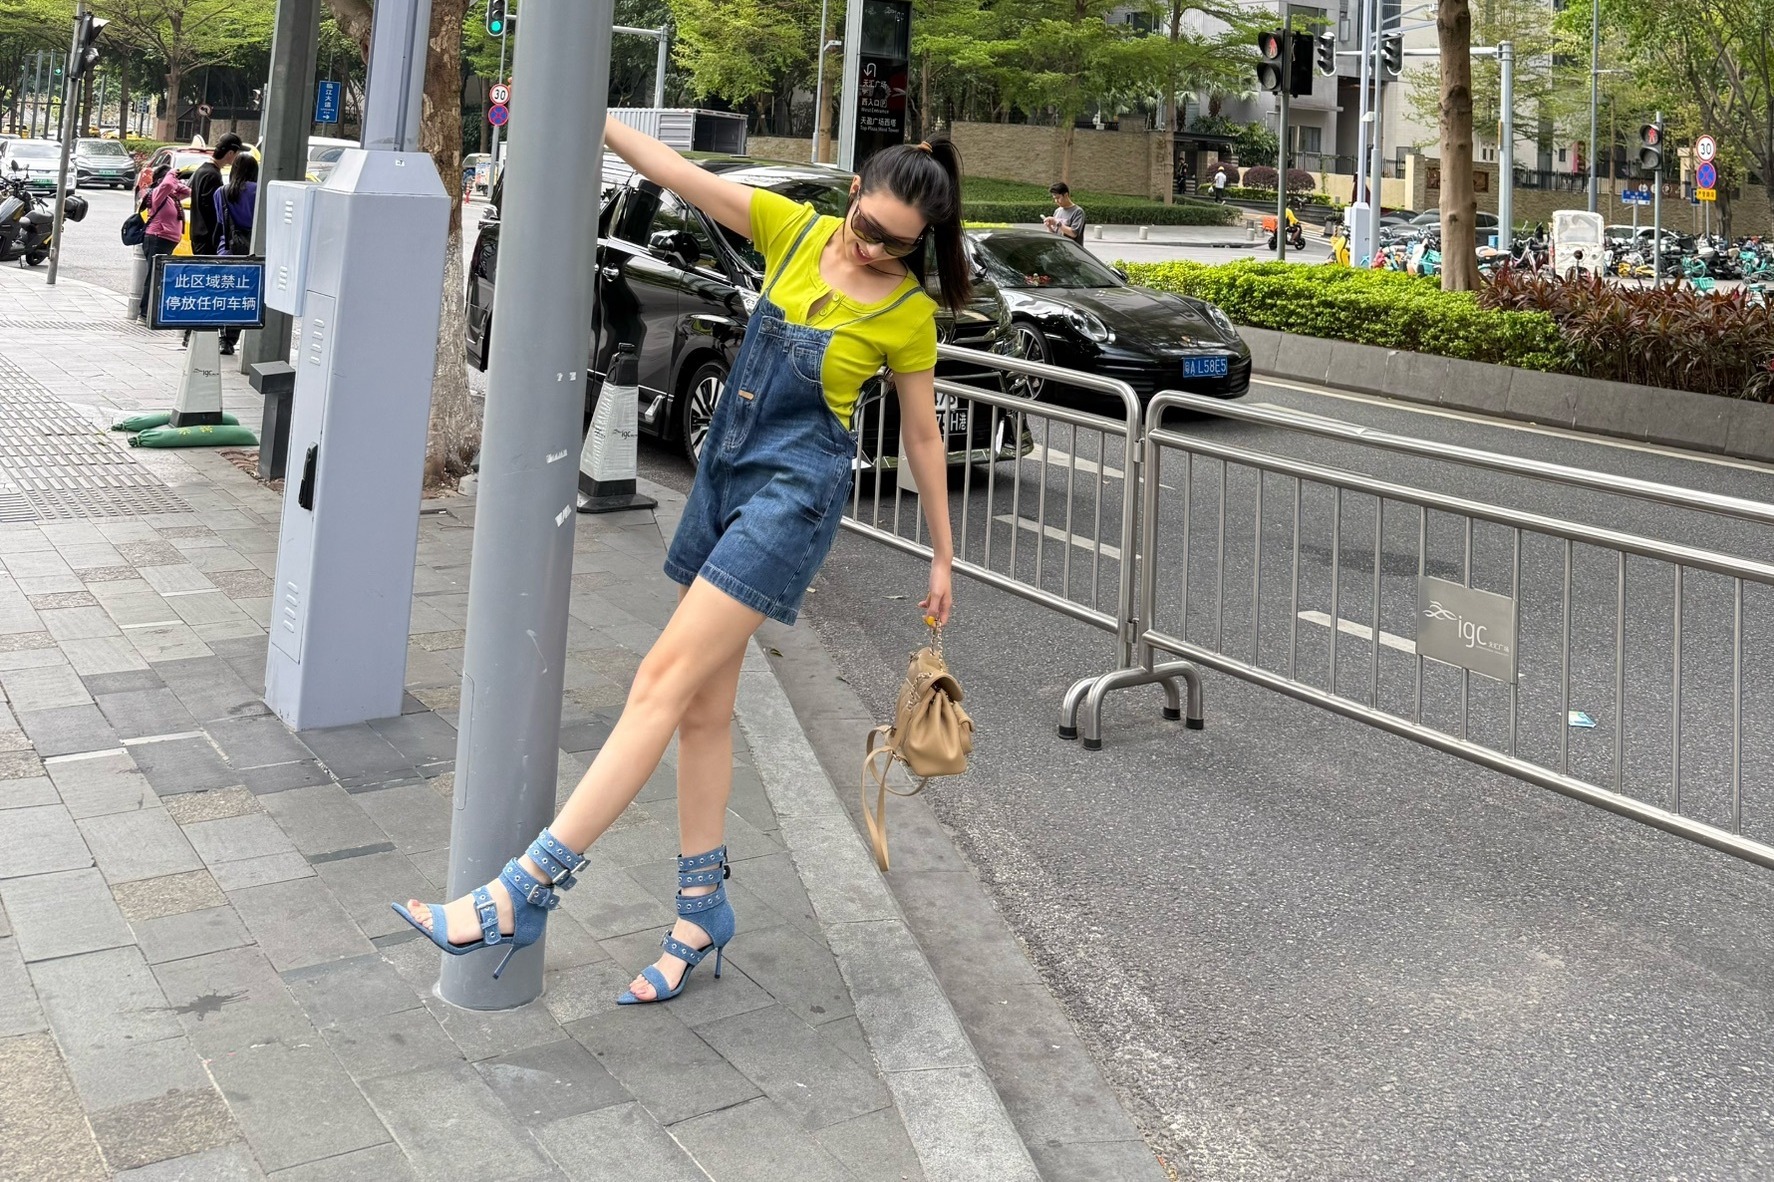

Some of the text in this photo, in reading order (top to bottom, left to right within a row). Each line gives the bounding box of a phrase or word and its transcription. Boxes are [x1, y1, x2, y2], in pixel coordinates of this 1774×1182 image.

[494, 89, 506, 100] 30
[1700, 143, 1712, 155] 30
[174, 274, 250, 289] 此区域禁止
[165, 296, 256, 311] 停放任何车辆
[1458, 615, 1487, 648] igc
